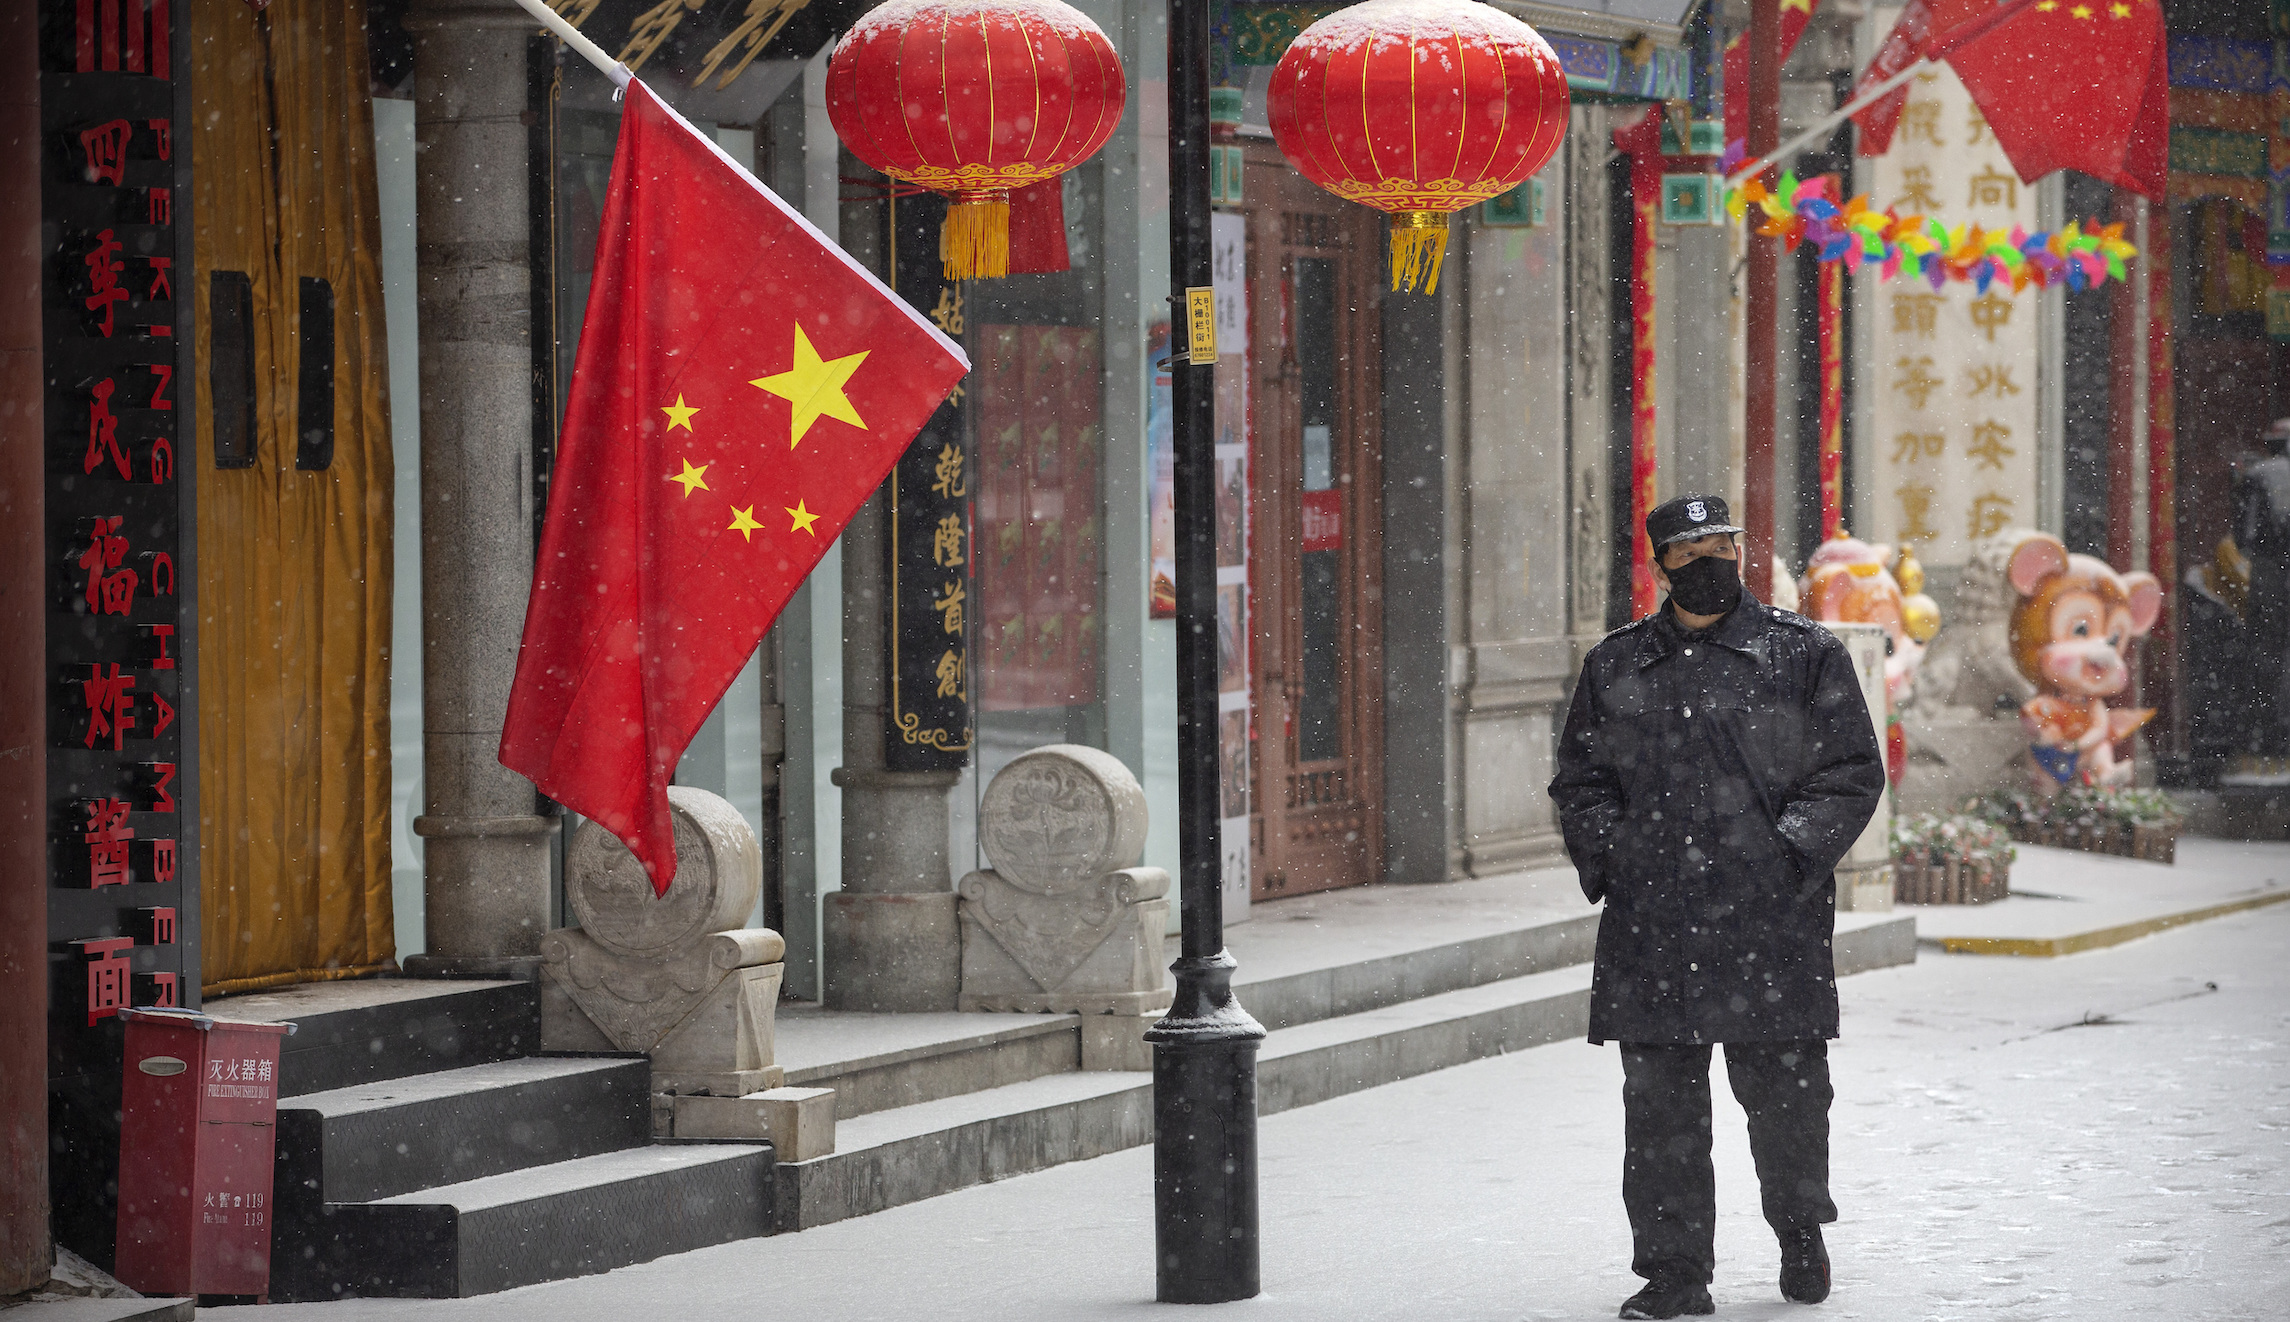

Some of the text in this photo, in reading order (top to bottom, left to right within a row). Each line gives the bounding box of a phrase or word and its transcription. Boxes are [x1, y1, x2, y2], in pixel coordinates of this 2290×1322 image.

[149, 118, 174, 485] PEKING
[1194, 296, 1205, 342] 大栅栏街
[1203, 297, 1211, 340] B10011
[79, 118, 139, 1028] 四季民福炸酱面
[151, 551, 176, 1009] CHAMBER
[208, 1058, 273, 1082] 灭火器箱
[244, 1211, 264, 1227] 119
[246, 1192, 264, 1209] 119
